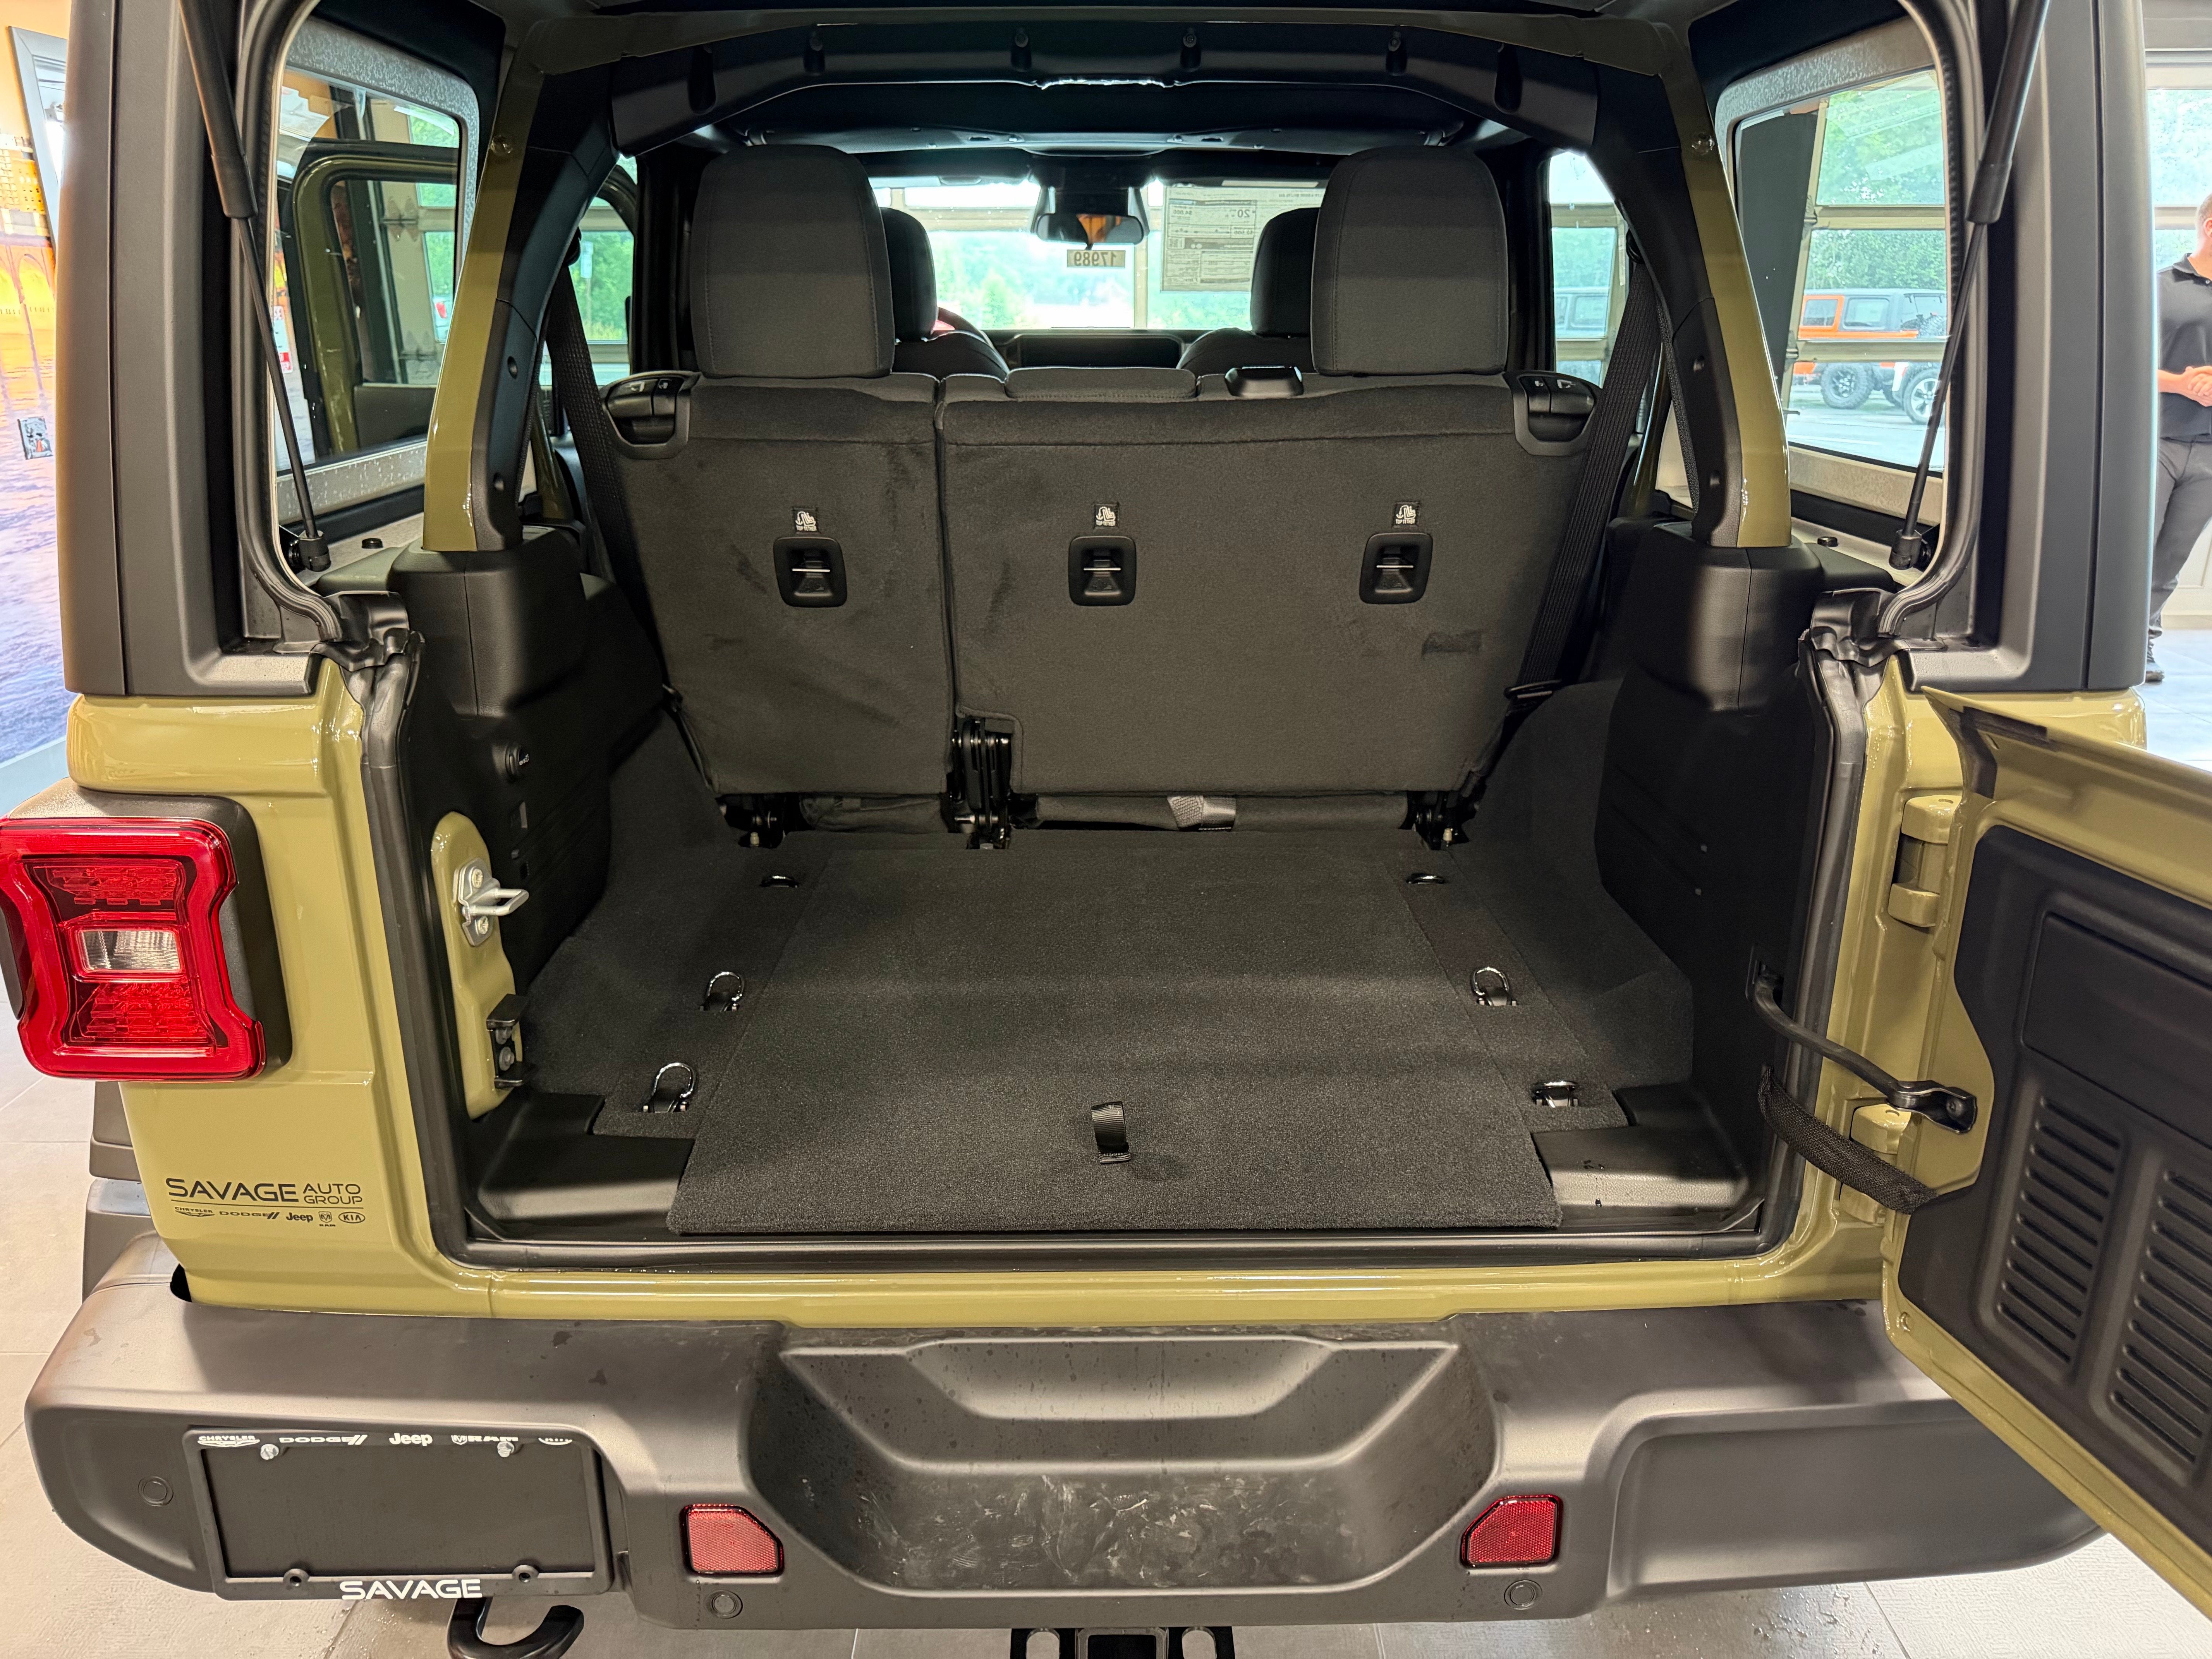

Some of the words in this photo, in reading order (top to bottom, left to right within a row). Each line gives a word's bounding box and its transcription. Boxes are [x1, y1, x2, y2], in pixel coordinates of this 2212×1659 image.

[166, 1178, 299, 1202] SAVAGE
[303, 1183, 361, 1194] AUTO
[304, 1195, 362, 1204] GROUP
[286, 1212, 313, 1223] Jeep
[389, 1433, 433, 1446] Jeep
[340, 1579, 483, 1600] SAVAGE
